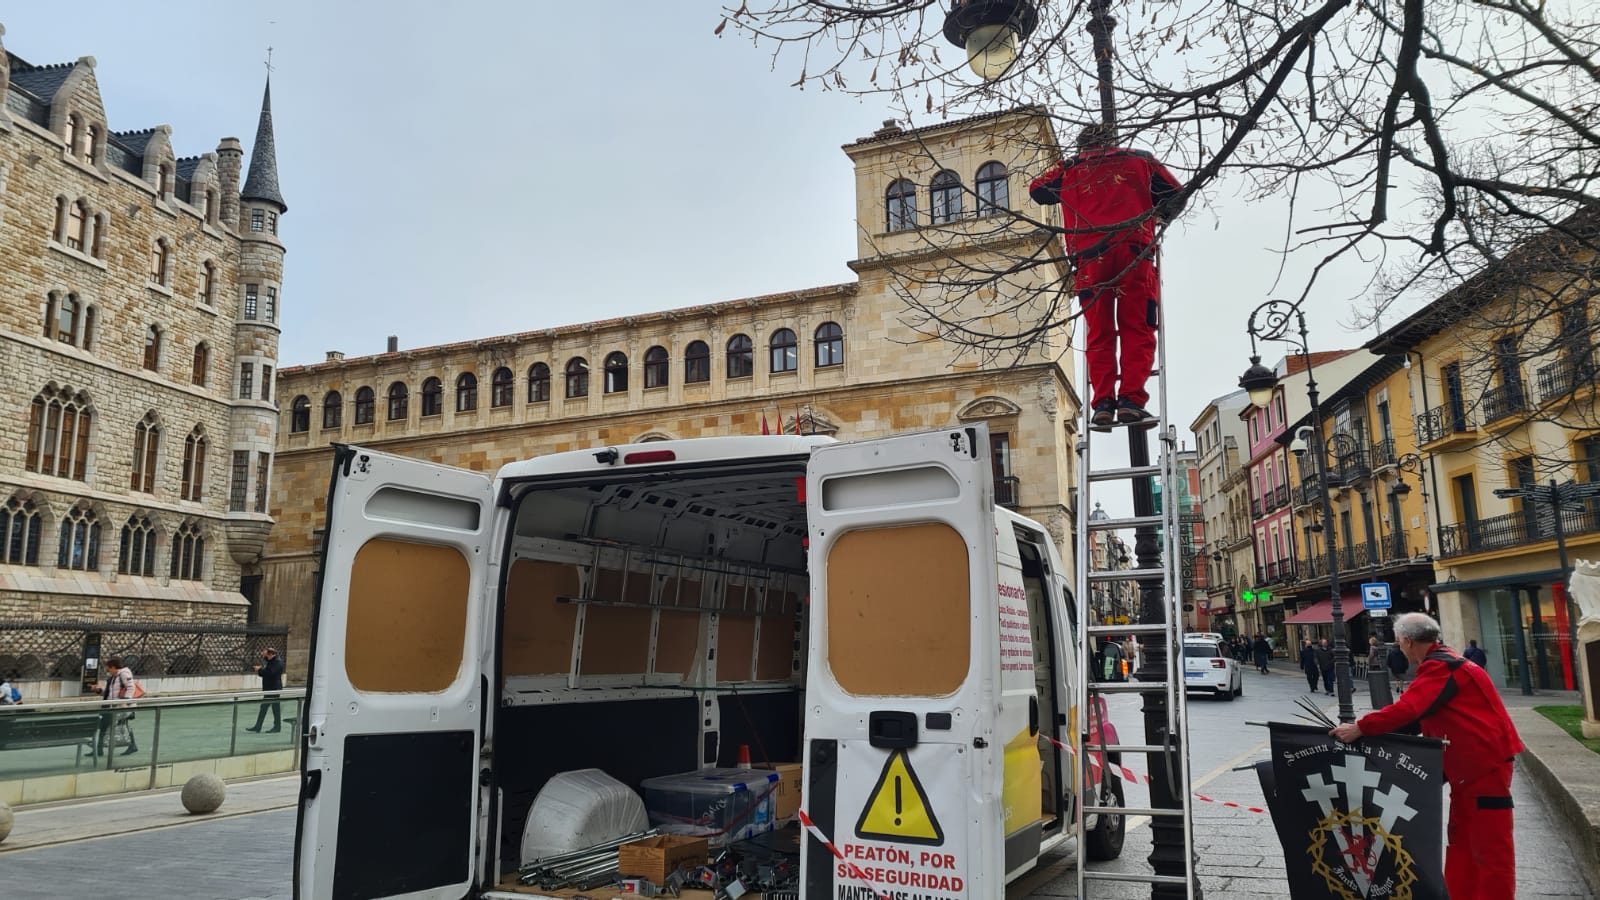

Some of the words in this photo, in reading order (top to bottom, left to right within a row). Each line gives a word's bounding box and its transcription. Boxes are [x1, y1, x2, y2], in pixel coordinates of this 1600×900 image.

[1283, 743, 1329, 766] Semana
[1378, 747, 1392, 760] de
[1395, 753, 1429, 780] León
[844, 844, 914, 868] PEATÓN,
[920, 852, 955, 870] POR
[838, 863, 860, 879] SU
[864, 867, 963, 892] SEGURIDAD
[1333, 866, 1358, 891] Junta
